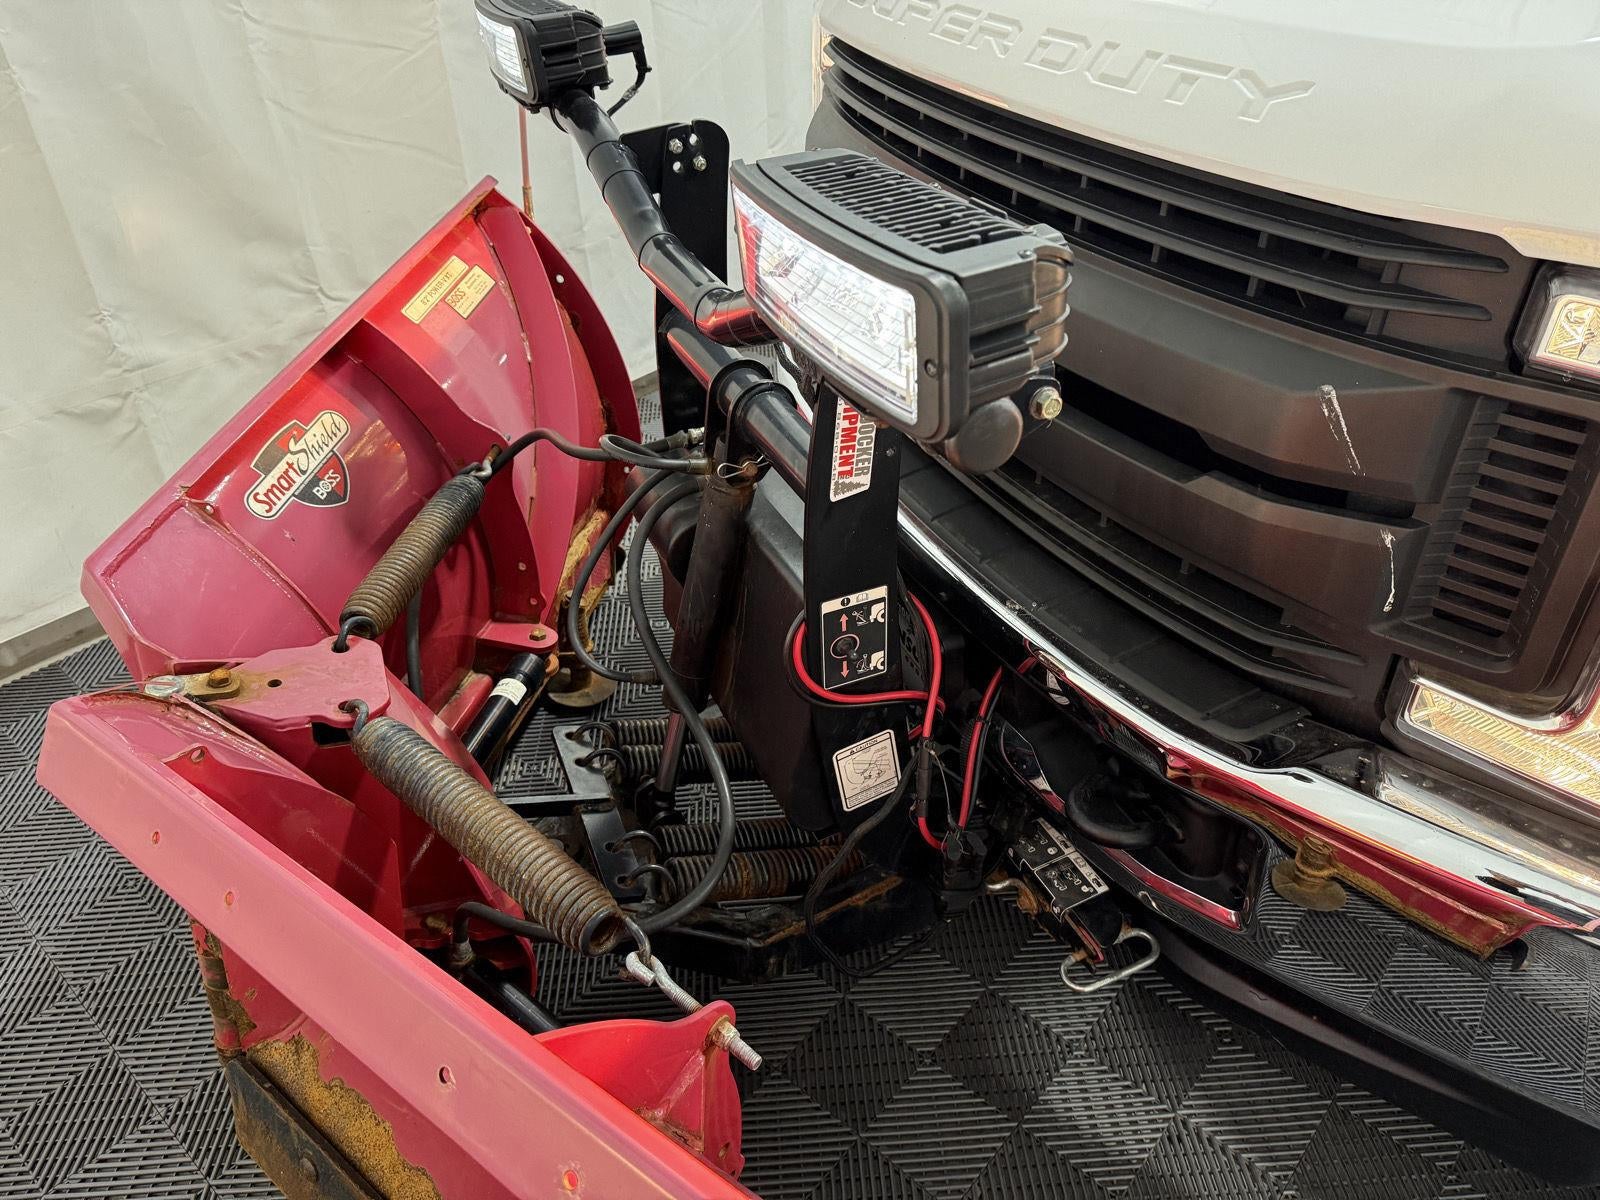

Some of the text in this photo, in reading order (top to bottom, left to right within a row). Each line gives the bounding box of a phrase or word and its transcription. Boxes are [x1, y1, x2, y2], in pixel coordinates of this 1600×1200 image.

[845, 0, 1317, 124] UPER DUTY
[446, 287, 466, 307] BOSS
[252, 411, 343, 514] Smart Shield
[838, 401, 860, 478] IPMENT
[312, 469, 341, 500] BOSS
[855, 739, 878, 752] CAUTION
